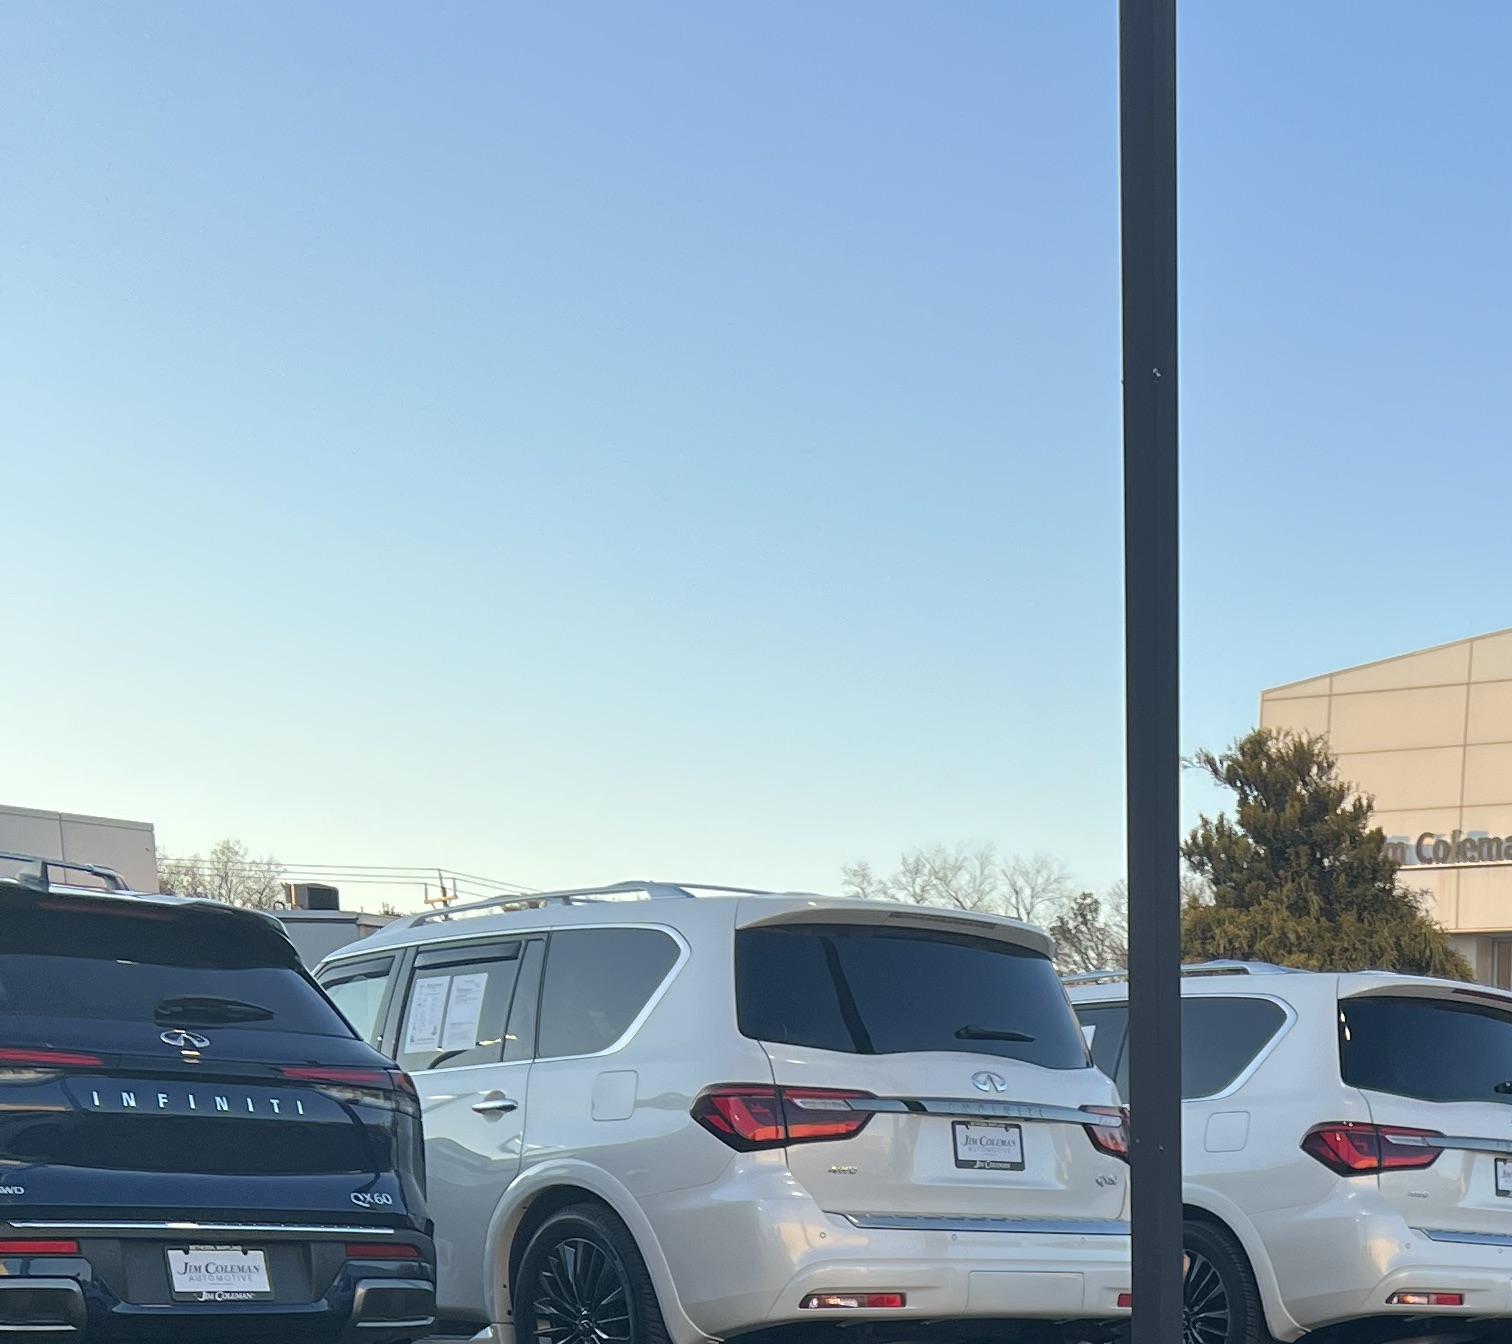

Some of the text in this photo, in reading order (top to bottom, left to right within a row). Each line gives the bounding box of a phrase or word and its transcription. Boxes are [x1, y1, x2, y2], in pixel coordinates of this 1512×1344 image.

[92, 1091, 305, 1115] INFINITI
[350, 1192, 393, 1208] QX60
[177, 1261, 260, 1276] JIM COLEMAN
[188, 1274, 253, 1282] AUTOMOTIVE
